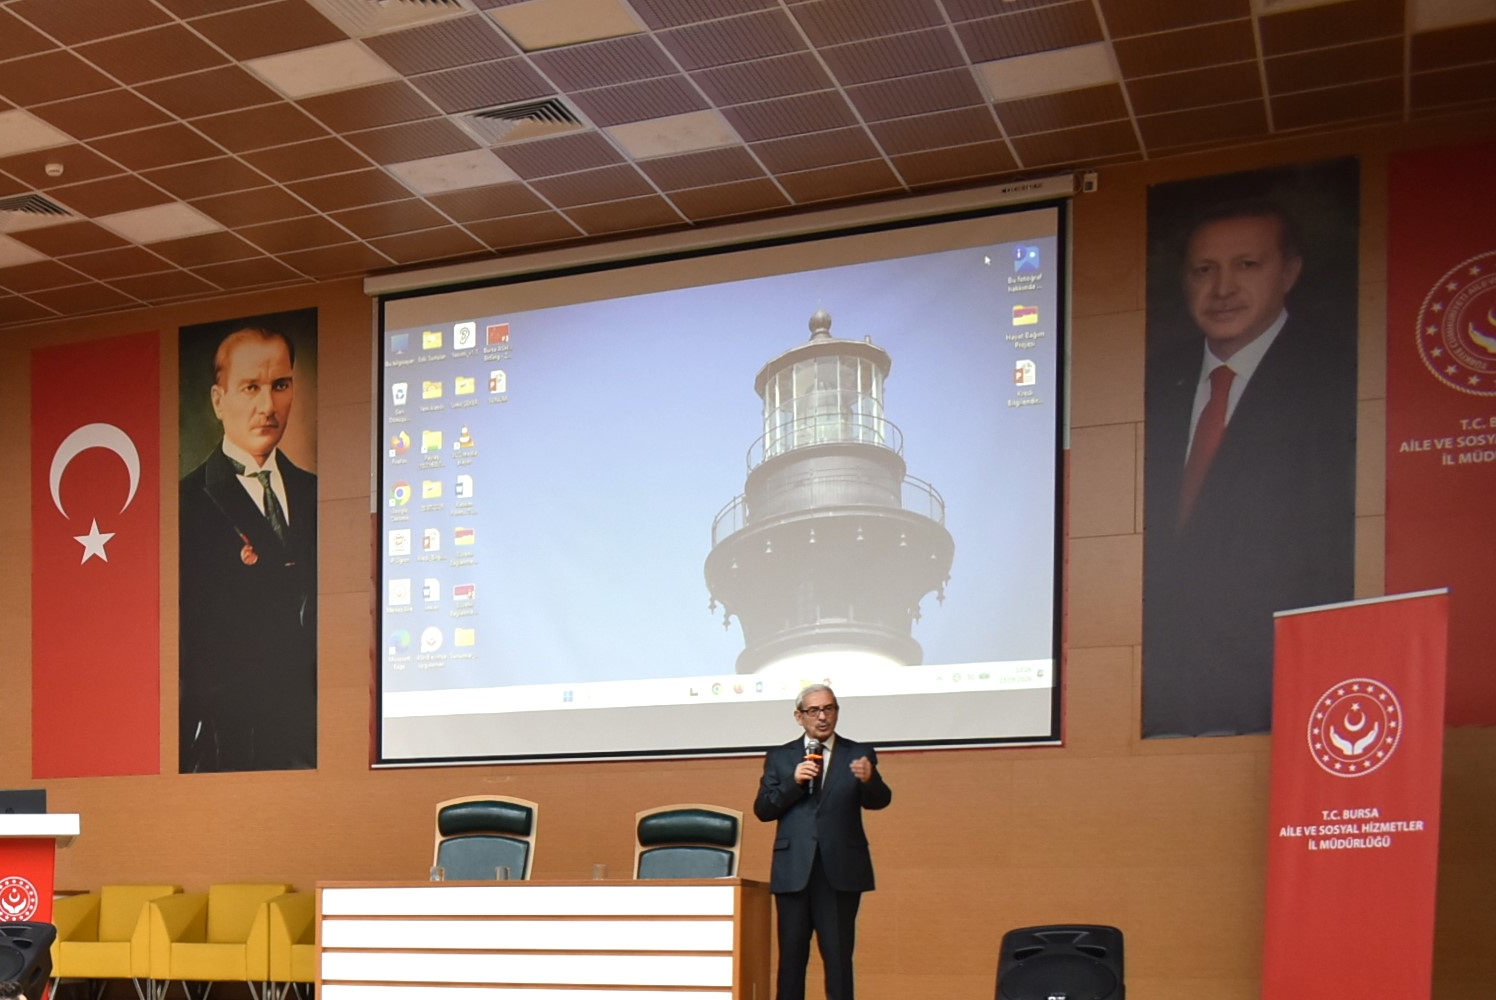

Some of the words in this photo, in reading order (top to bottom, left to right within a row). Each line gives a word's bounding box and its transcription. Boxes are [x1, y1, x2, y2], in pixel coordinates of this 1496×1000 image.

[1460, 418, 1486, 430] T.C.
[1399, 438, 1432, 453] AİLE
[1434, 437, 1453, 450] VE
[1456, 434, 1496, 448] SOSY
[1442, 453, 1455, 466] İL
[1322, 810, 1340, 820] T.C.
[1343, 808, 1379, 820] BURSA
[1279, 824, 1303, 837] AİLE
[1304, 825, 1317, 836] VE
[1319, 823, 1359, 835] SOSYAL
[1361, 820, 1424, 833] HİZMETLER
[1308, 837, 1318, 850] İL
[1319, 835, 1391, 850] MÜDÜRLÜĞÜ
